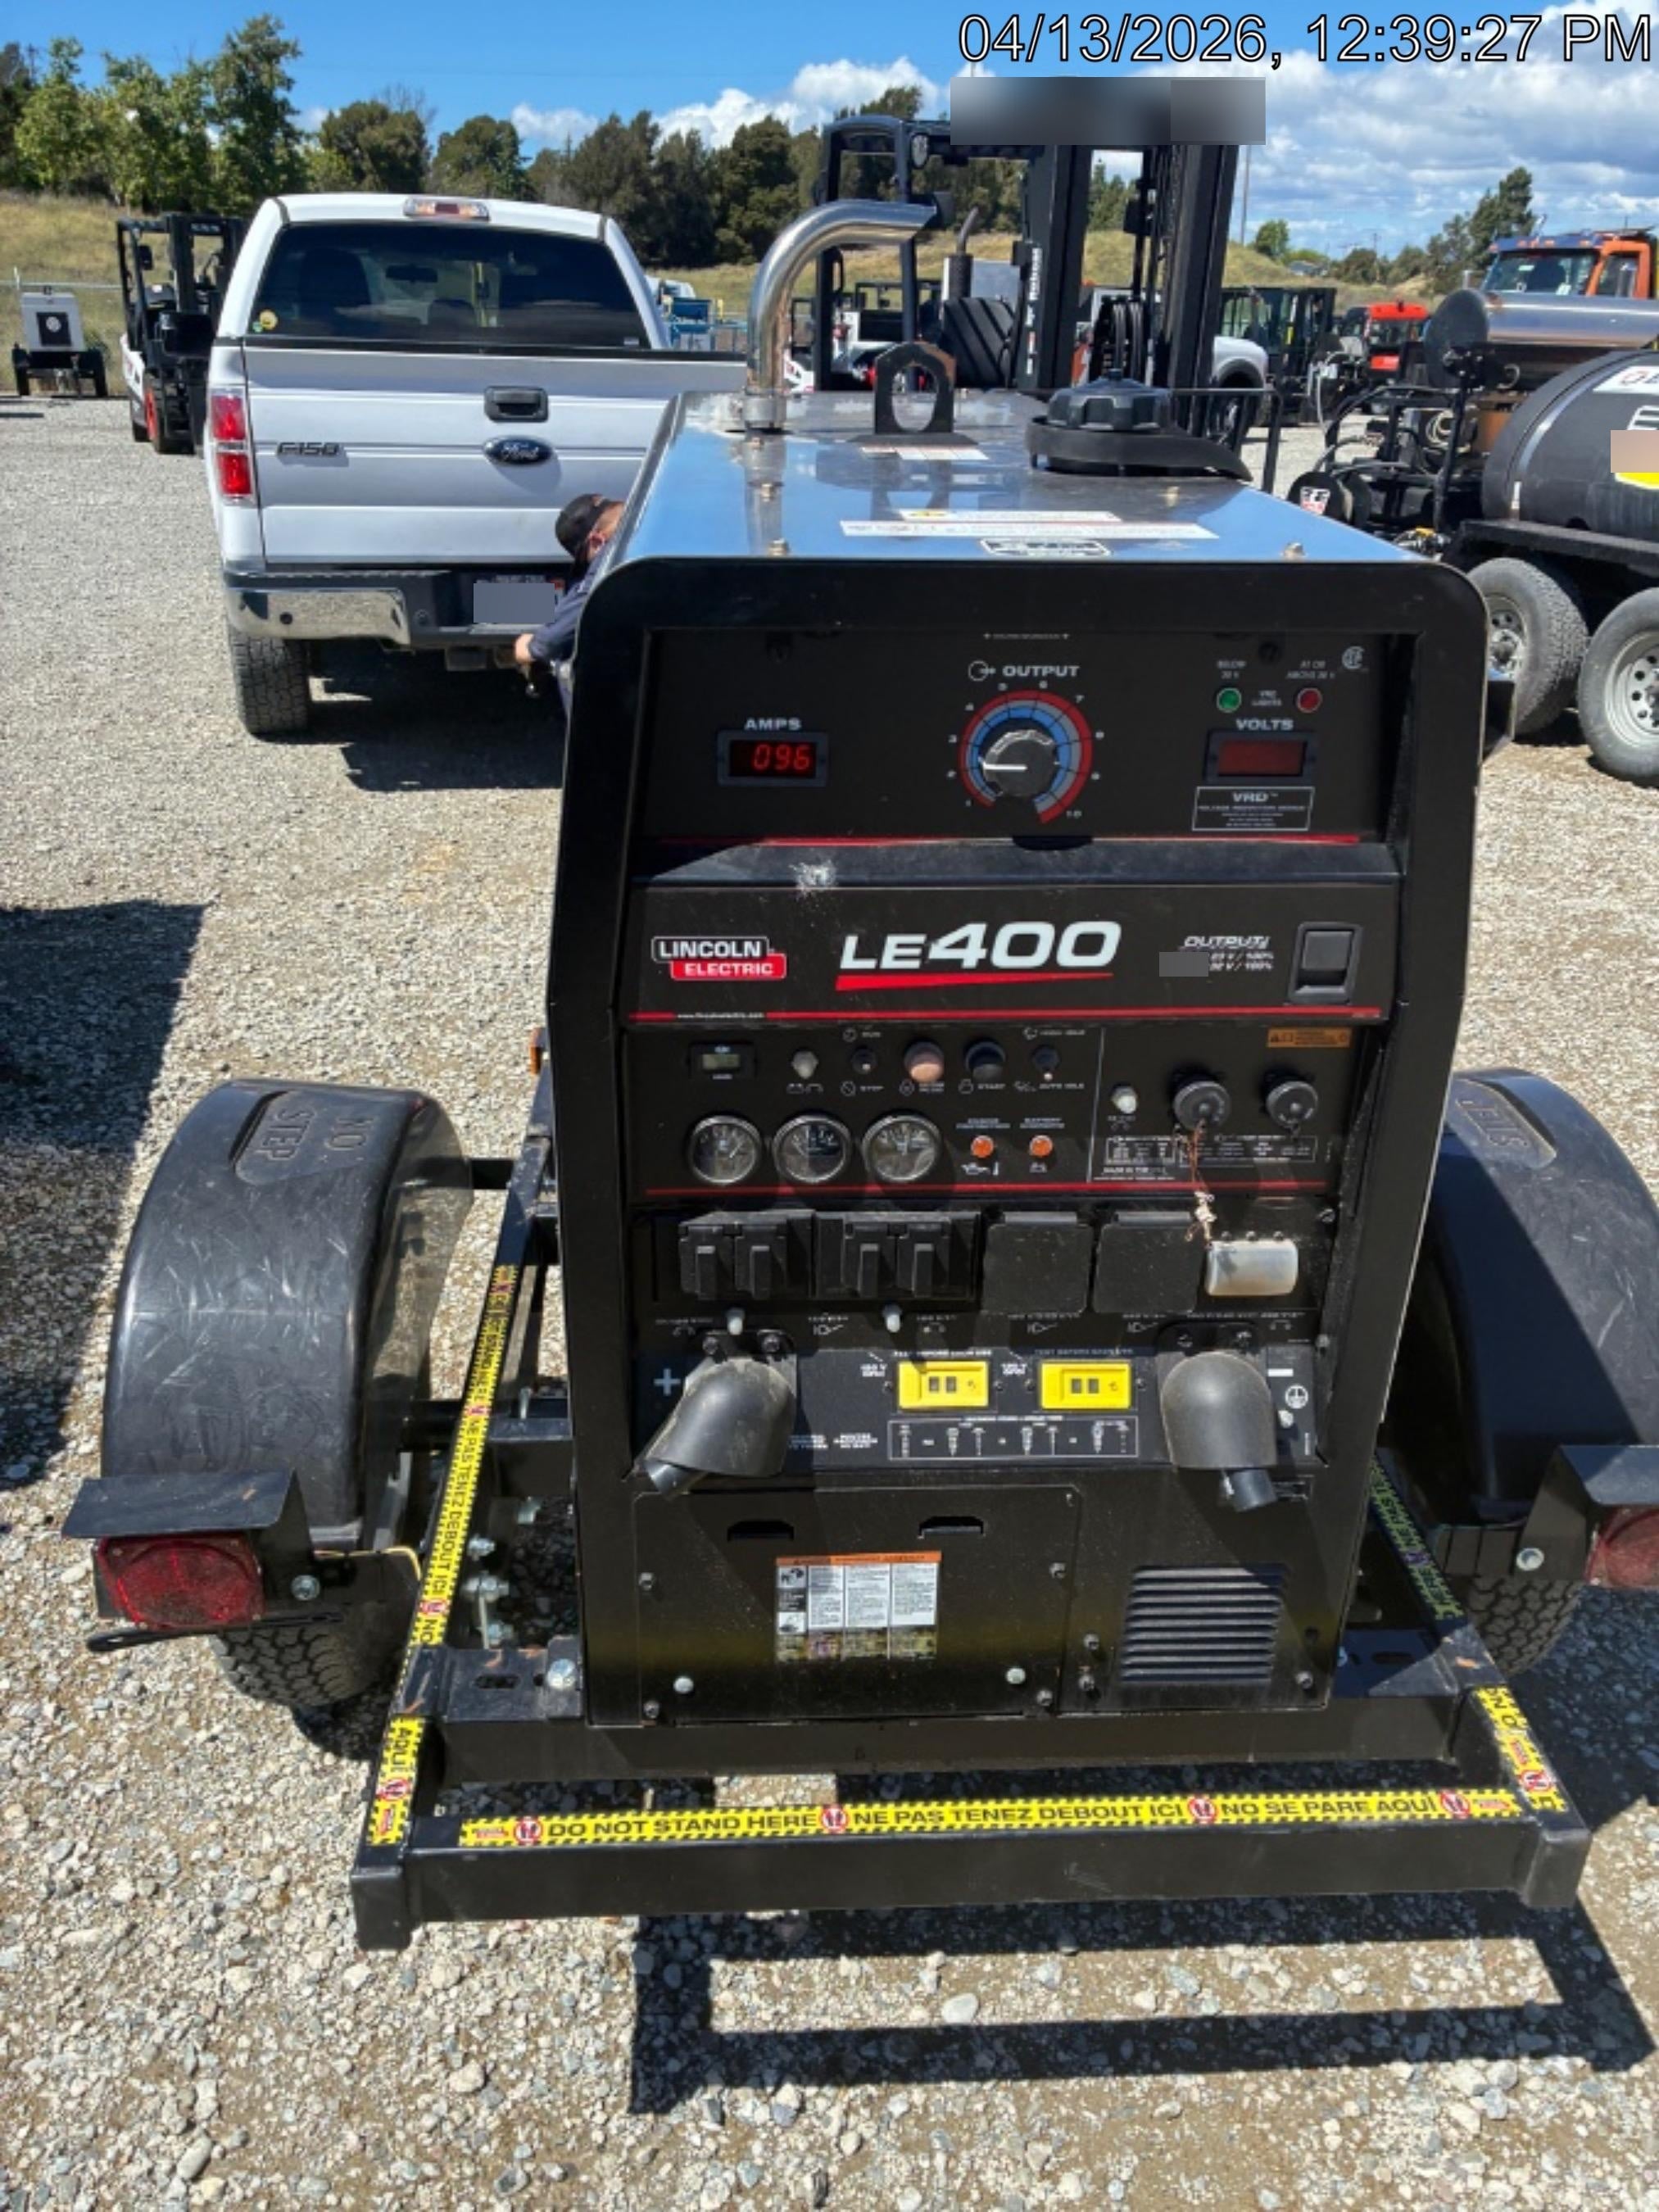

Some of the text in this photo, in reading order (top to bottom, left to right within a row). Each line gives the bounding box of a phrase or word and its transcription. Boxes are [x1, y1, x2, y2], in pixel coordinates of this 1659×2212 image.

[1002, 664, 1080, 678] OUTPUT
[744, 716, 802, 731] AMPS
[1235, 718, 1294, 732] VOLTS
[751, 742, 811, 772] 096
[659, 941, 761, 958] LINCOLN
[840, 920, 1122, 970] LE400
[683, 962, 773, 977] ELECTRIC
[438, 1511, 463, 1571] DEBOUT
[854, 1803, 1185, 1825] NE PAS TENEZ DEBOUT ICI
[1221, 1802, 1260, 1815] NO
[1265, 1801, 1299, 1814] SE
[1304, 1799, 1372, 1813] PARE
[547, 1813, 818, 1837] DO NOT STAND HERE
